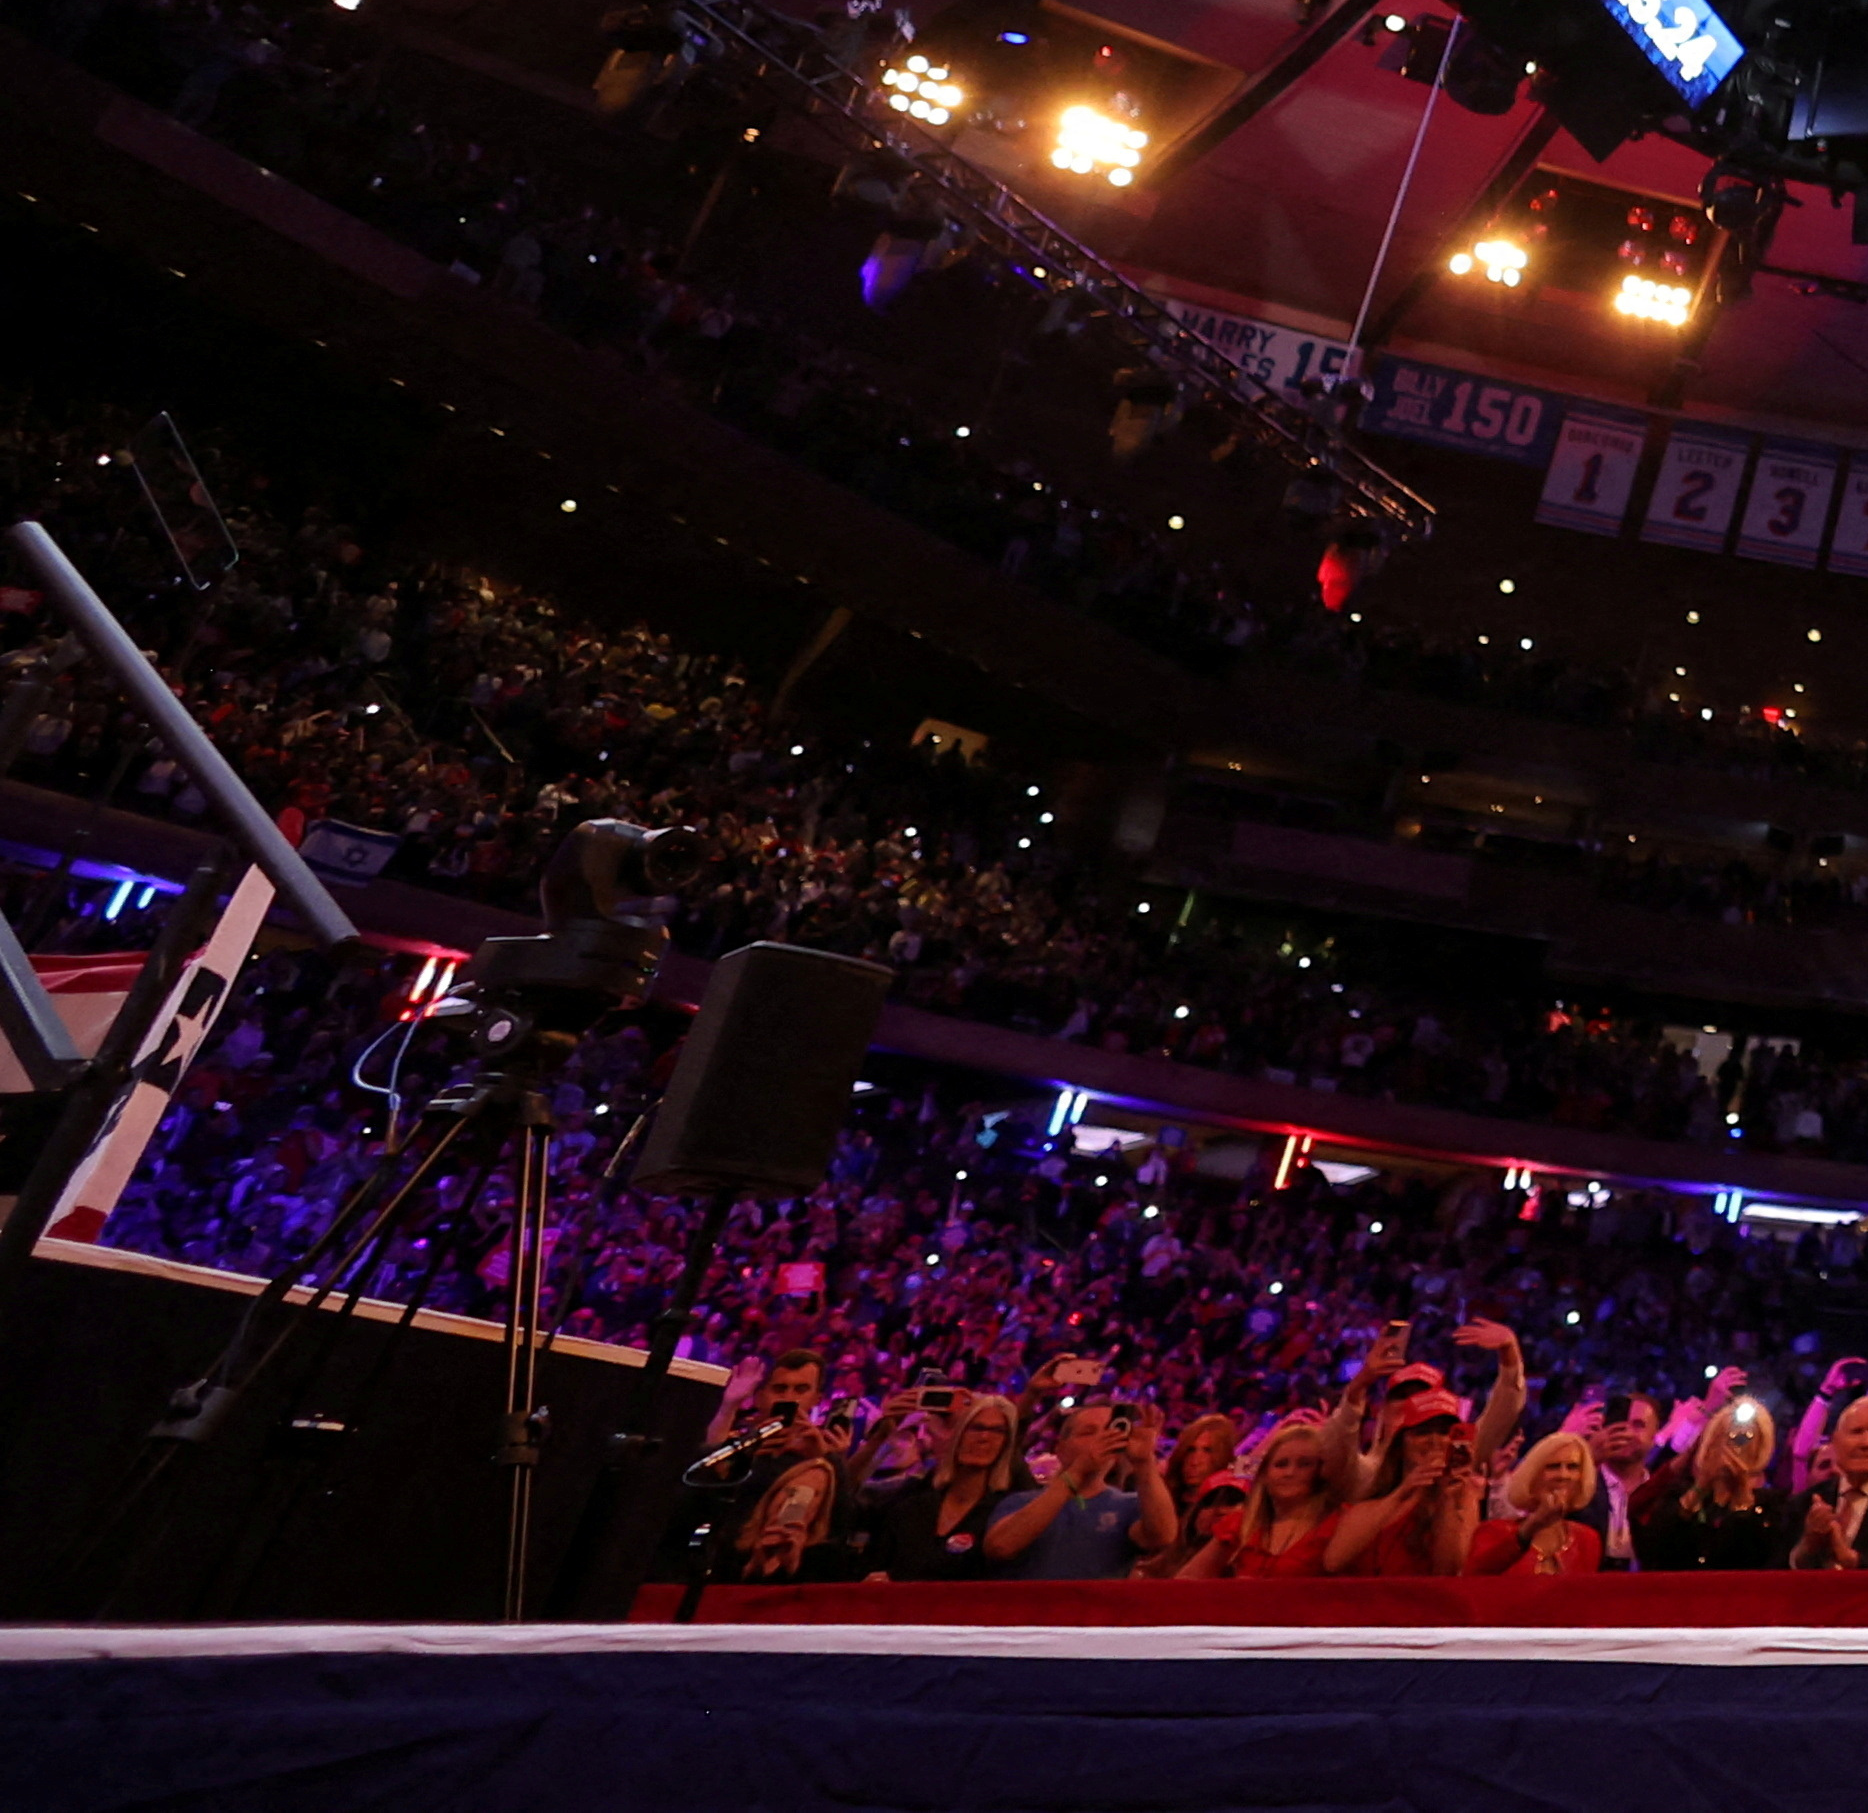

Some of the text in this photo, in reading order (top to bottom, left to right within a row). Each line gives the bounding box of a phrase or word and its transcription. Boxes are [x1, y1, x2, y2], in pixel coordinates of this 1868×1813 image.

[1181, 310, 1276, 356] HARRY
[1392, 366, 1450, 399] BILLY
[1385, 396, 1434, 427] JOEL
[1442, 381, 1544, 448] 150
[1572, 453, 1603, 505] 1
[1672, 469, 1716, 522] 2
[1767, 486, 1806, 537] 3
